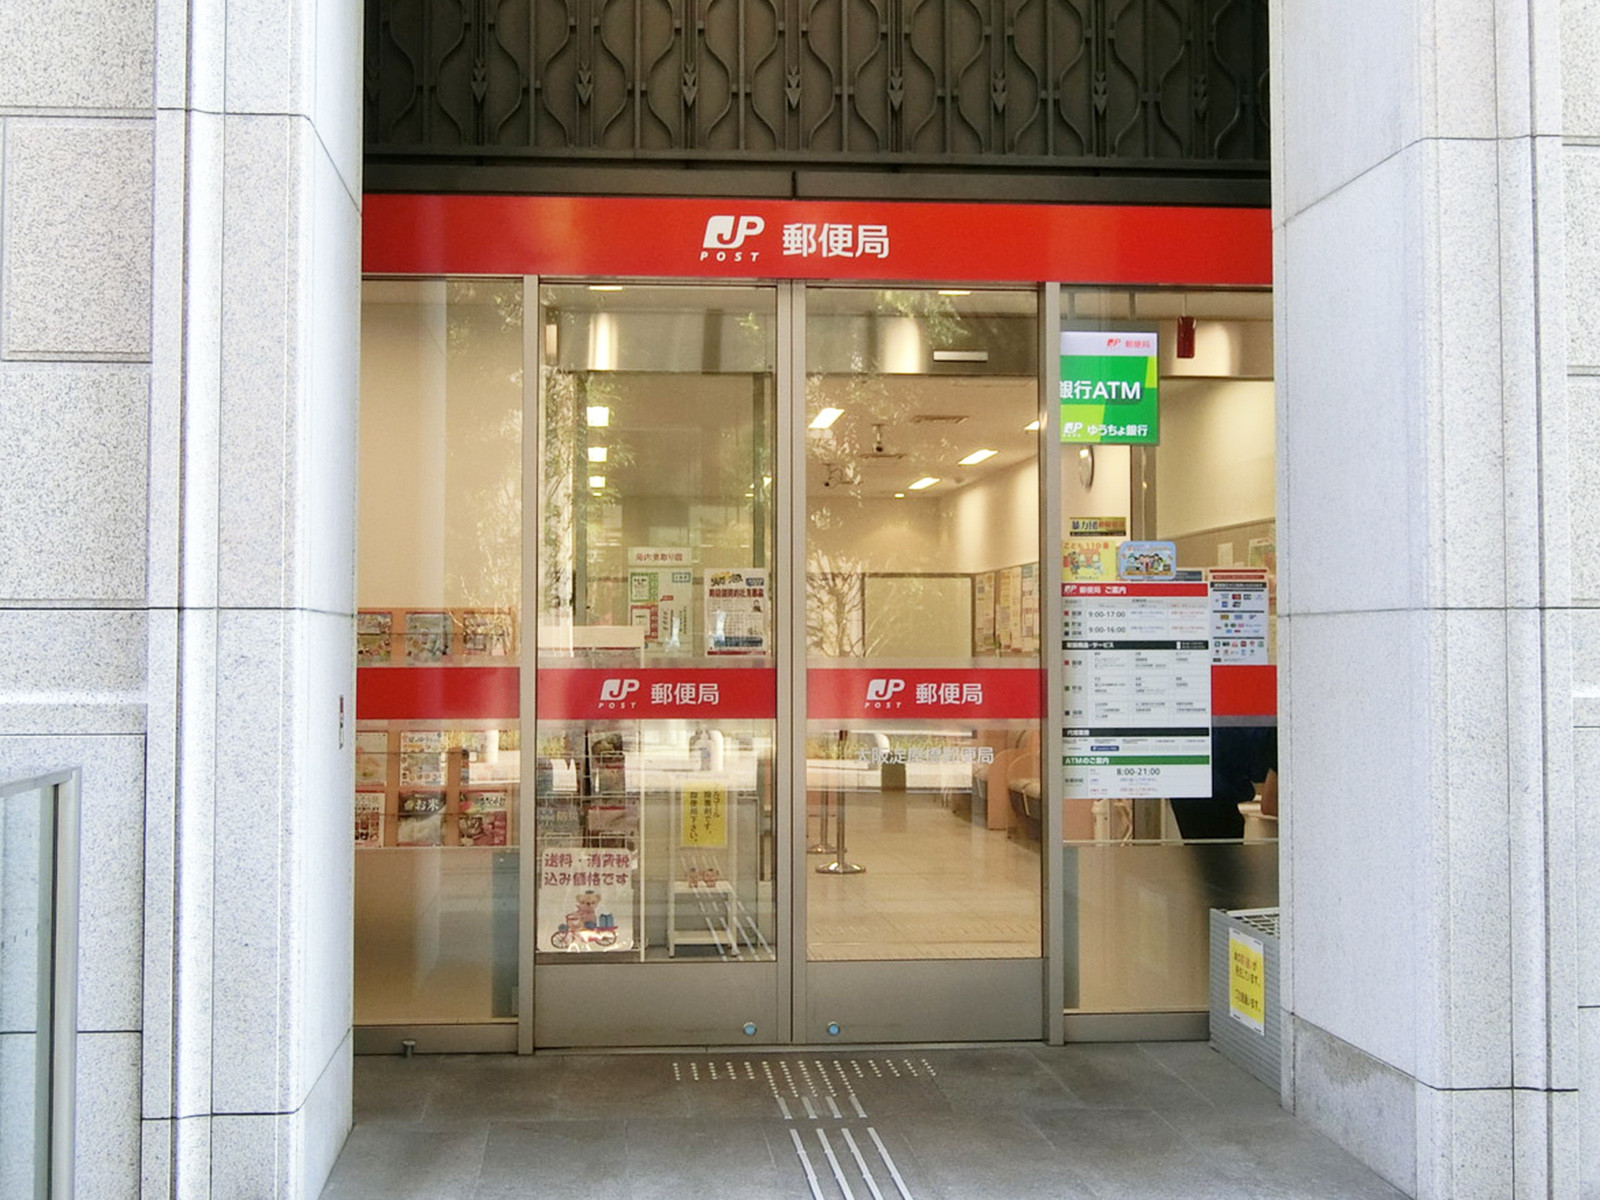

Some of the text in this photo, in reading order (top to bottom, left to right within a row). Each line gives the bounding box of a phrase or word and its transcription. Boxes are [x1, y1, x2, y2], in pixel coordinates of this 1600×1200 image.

[703, 215, 890, 259] JP 郵便局
[700, 251, 760, 262] POST
[1087, 424, 1148, 437] ゆうちょ銀行
[600, 678, 720, 706] JP 郵便局
[866, 678, 983, 706] JP 郵便局
[1116, 767, 1160, 775] 8:00-21:00
[414, 799, 440, 812] お米
[544, 852, 630, 869] 送料・消費税
[544, 871, 629, 887] 込み価格です
